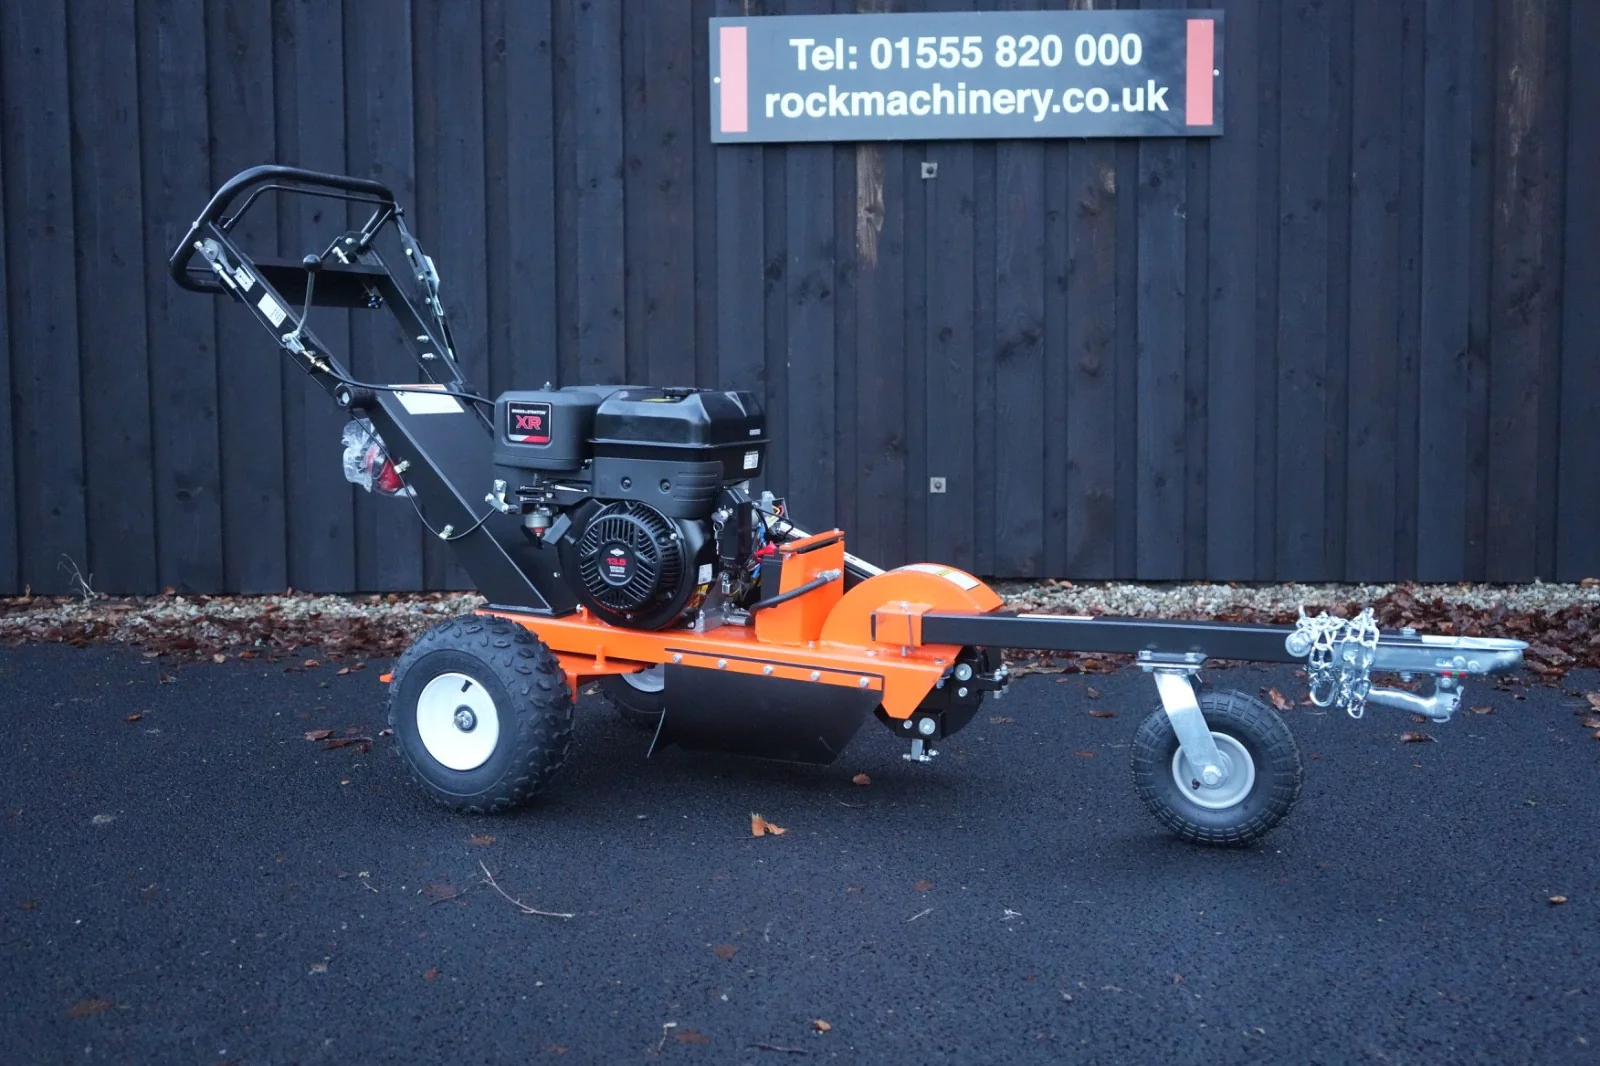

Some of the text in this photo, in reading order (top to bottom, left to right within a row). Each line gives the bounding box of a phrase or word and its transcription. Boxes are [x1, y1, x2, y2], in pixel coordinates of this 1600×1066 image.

[789, 33, 1142, 71] Tel: 01555 820 000
[765, 80, 1169, 122] rockmachinery.co.uk
[516, 415, 541, 430] XR
